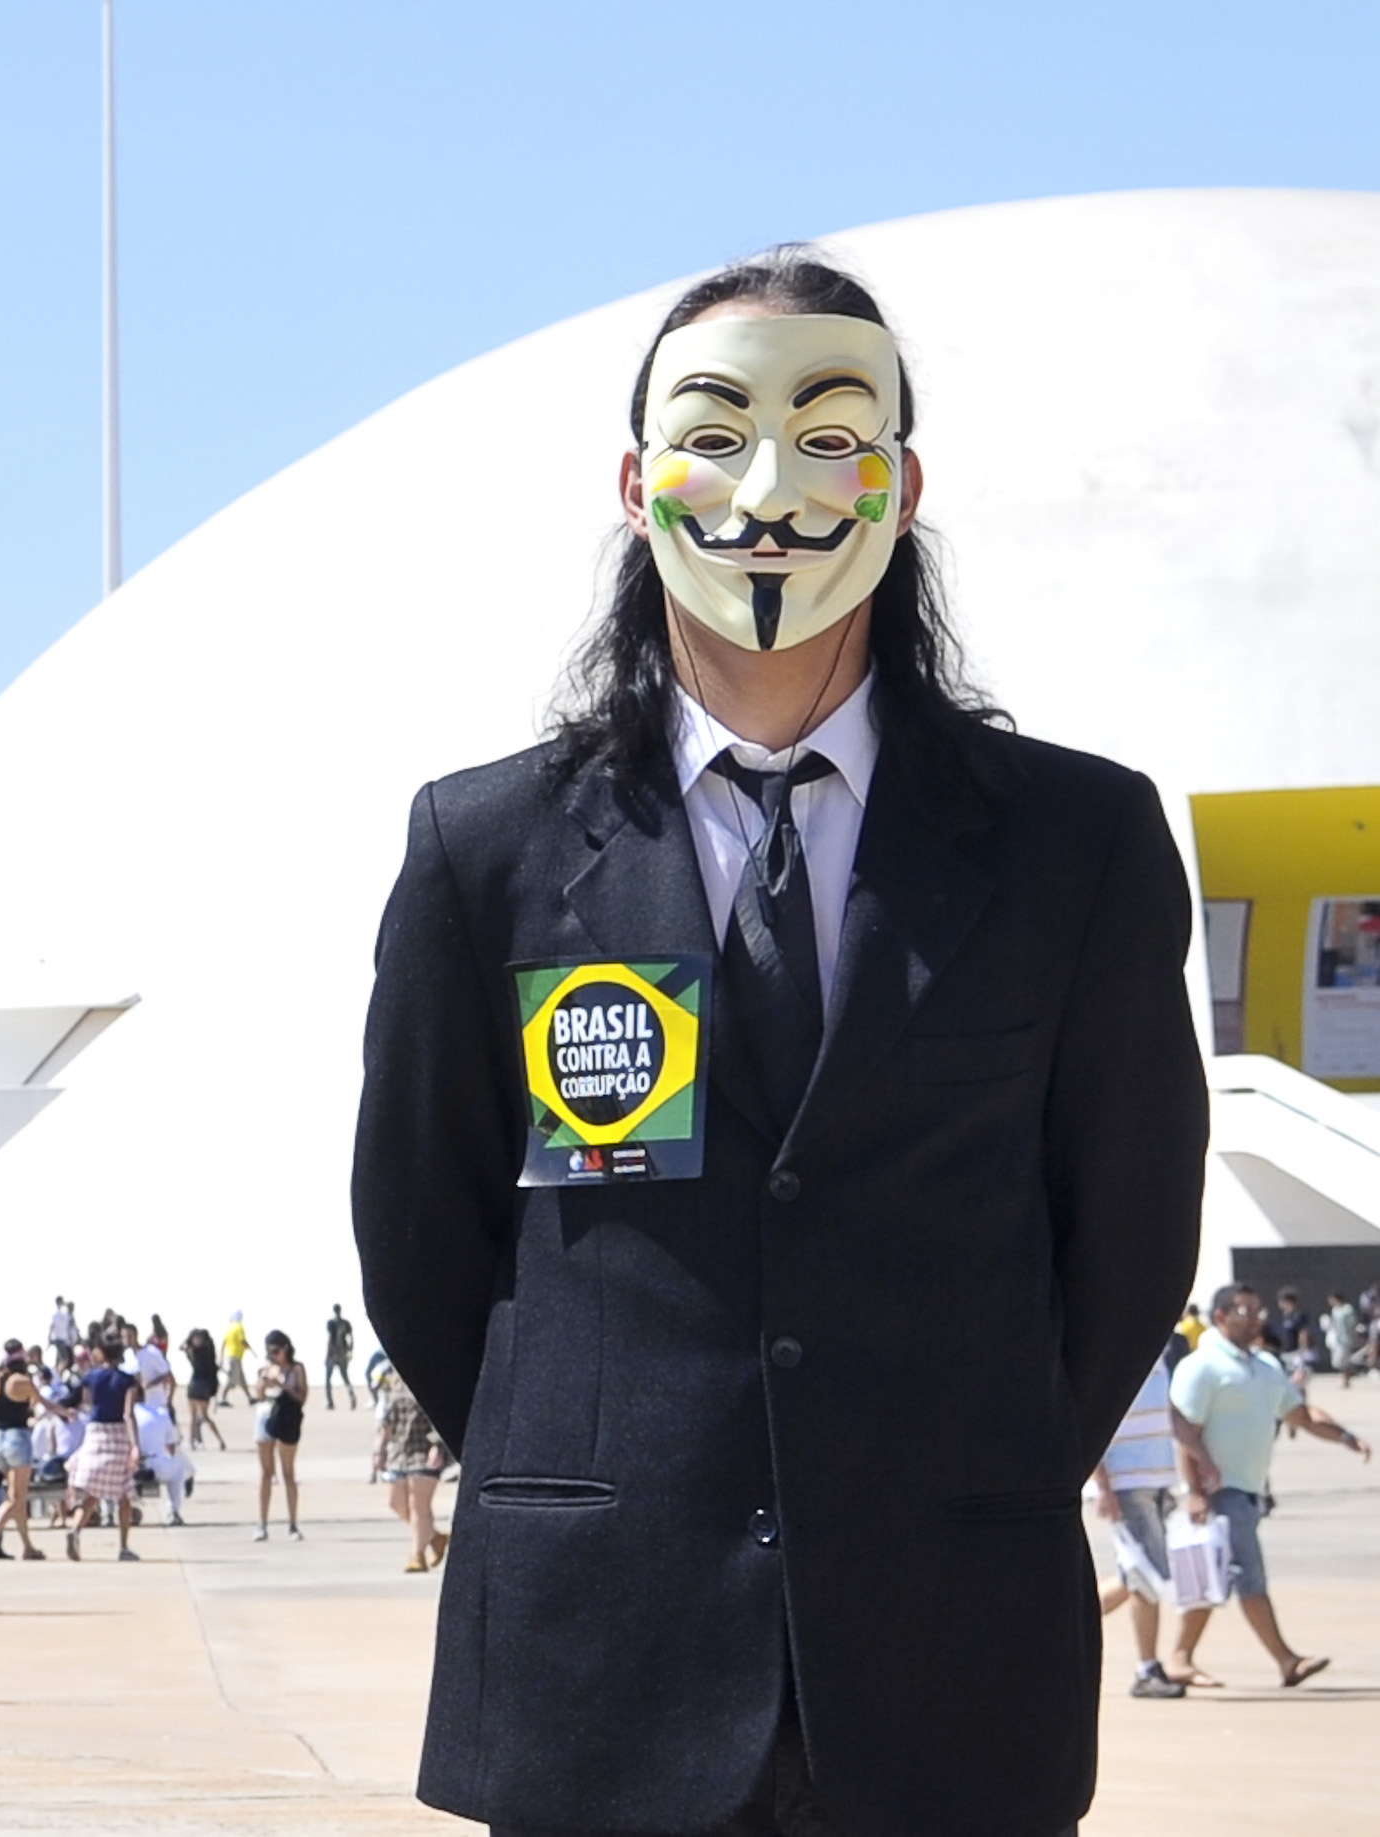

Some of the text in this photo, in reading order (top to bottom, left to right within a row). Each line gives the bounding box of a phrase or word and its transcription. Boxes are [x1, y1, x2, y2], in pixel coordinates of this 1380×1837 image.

[554, 1003, 653, 1045] BRASIL
[556, 1041, 652, 1073] CONTRA A
[560, 1067, 651, 1100] CORRUPÇÃO
